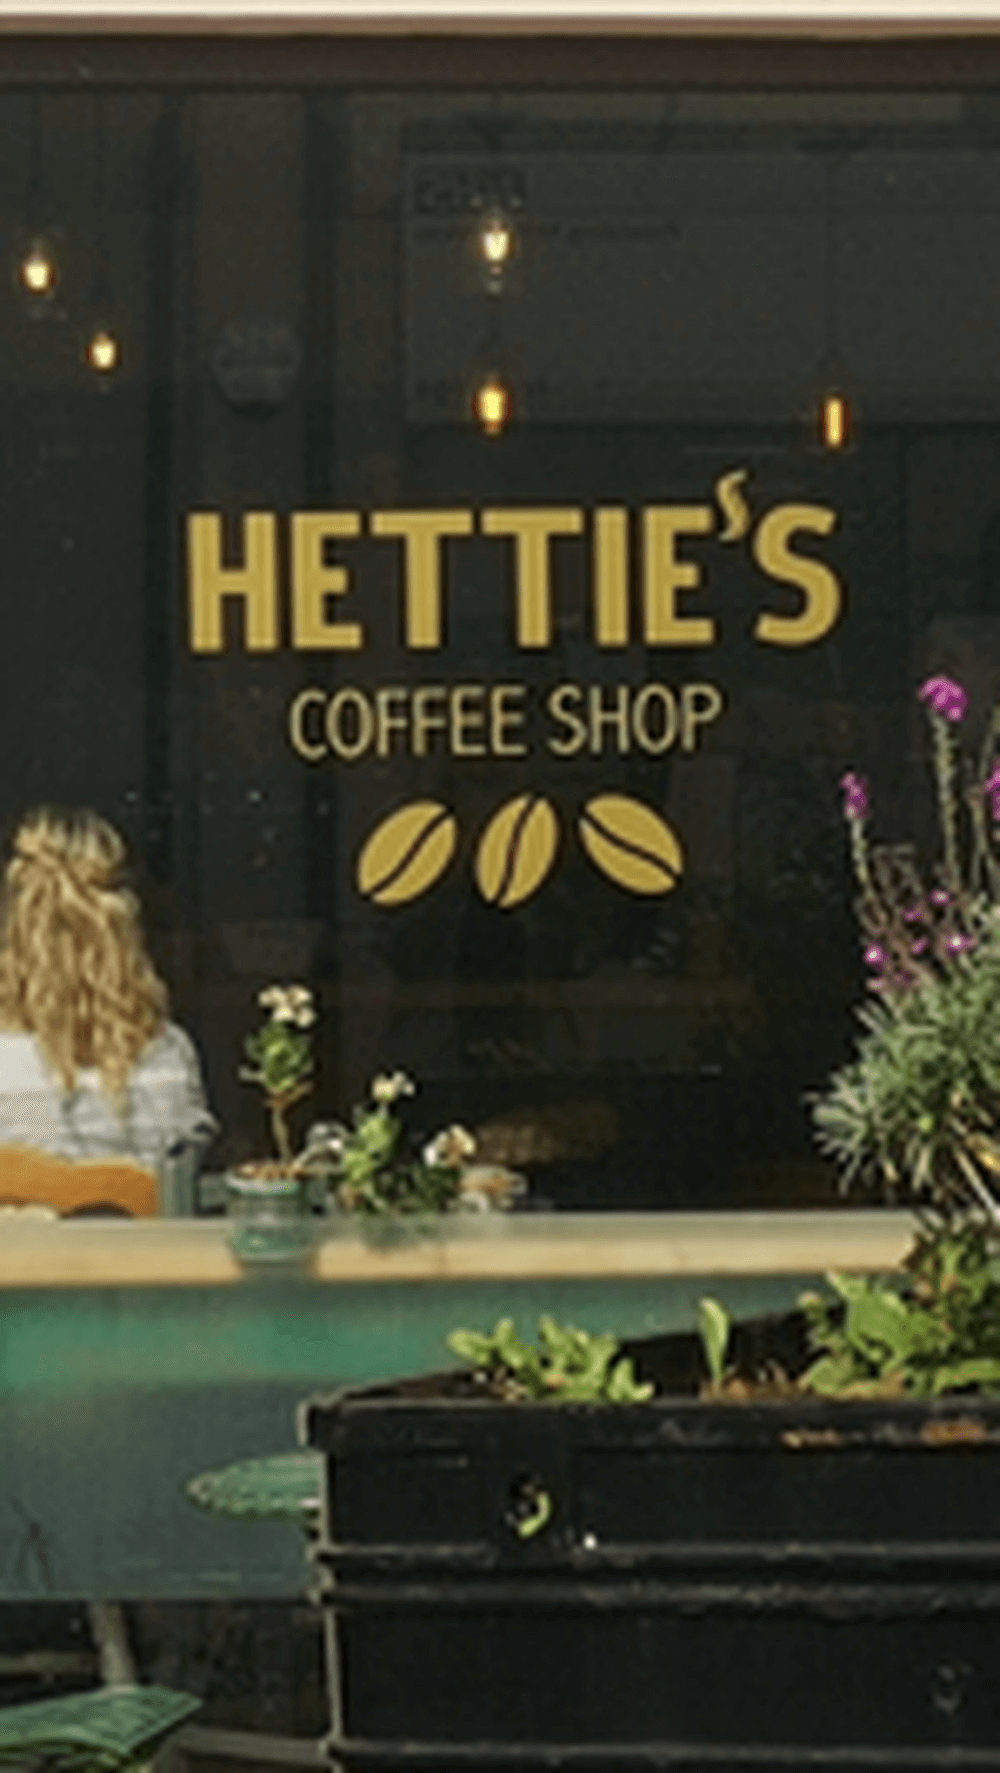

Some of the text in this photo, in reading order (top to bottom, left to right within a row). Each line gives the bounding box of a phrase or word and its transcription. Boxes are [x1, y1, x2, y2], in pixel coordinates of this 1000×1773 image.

[187, 470, 840, 651] HETTIE'S
[290, 684, 721, 758] COFFEE SHOP
